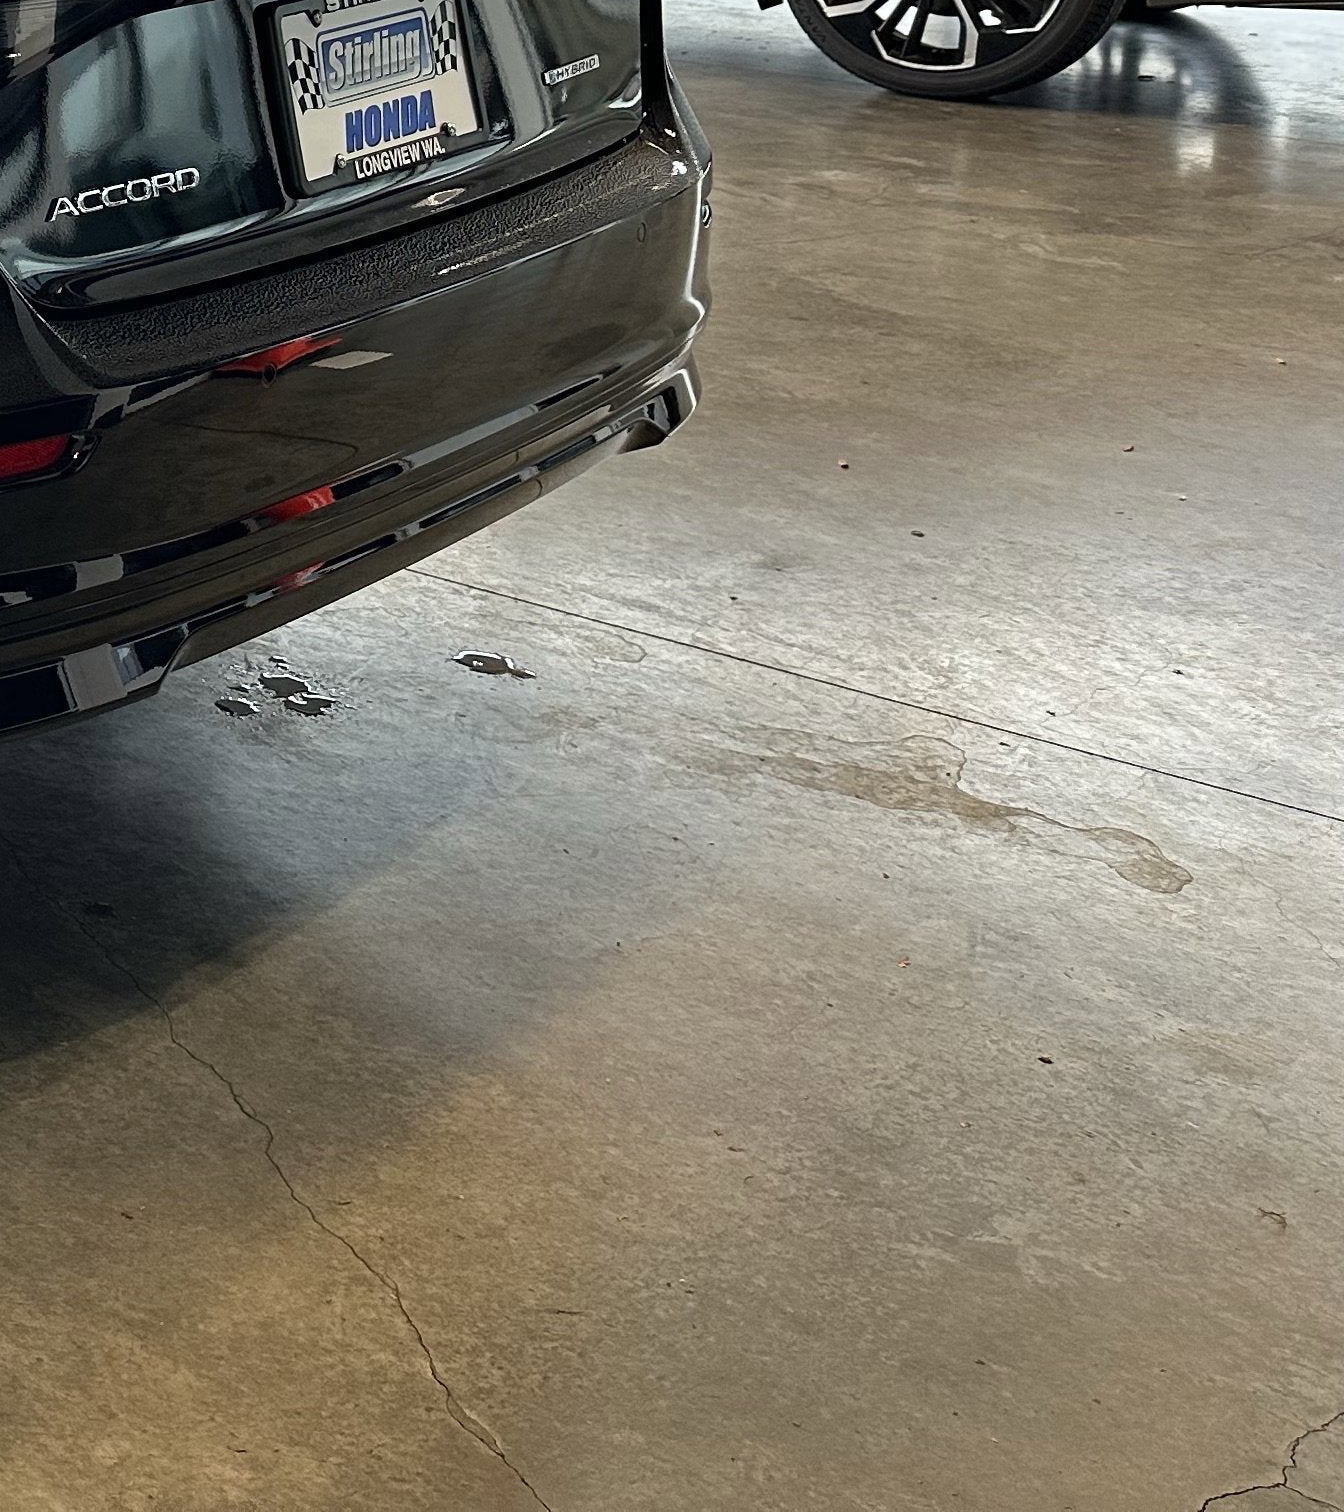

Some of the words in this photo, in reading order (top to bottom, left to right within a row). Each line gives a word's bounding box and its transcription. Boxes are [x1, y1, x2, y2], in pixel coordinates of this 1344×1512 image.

[328, 28, 421, 90] Stirling
[556, 57, 596, 80] HYBRID
[345, 89, 436, 153] HONDA
[355, 143, 420, 179] LONGVIEW
[47, 167, 200, 222] ACCORD
